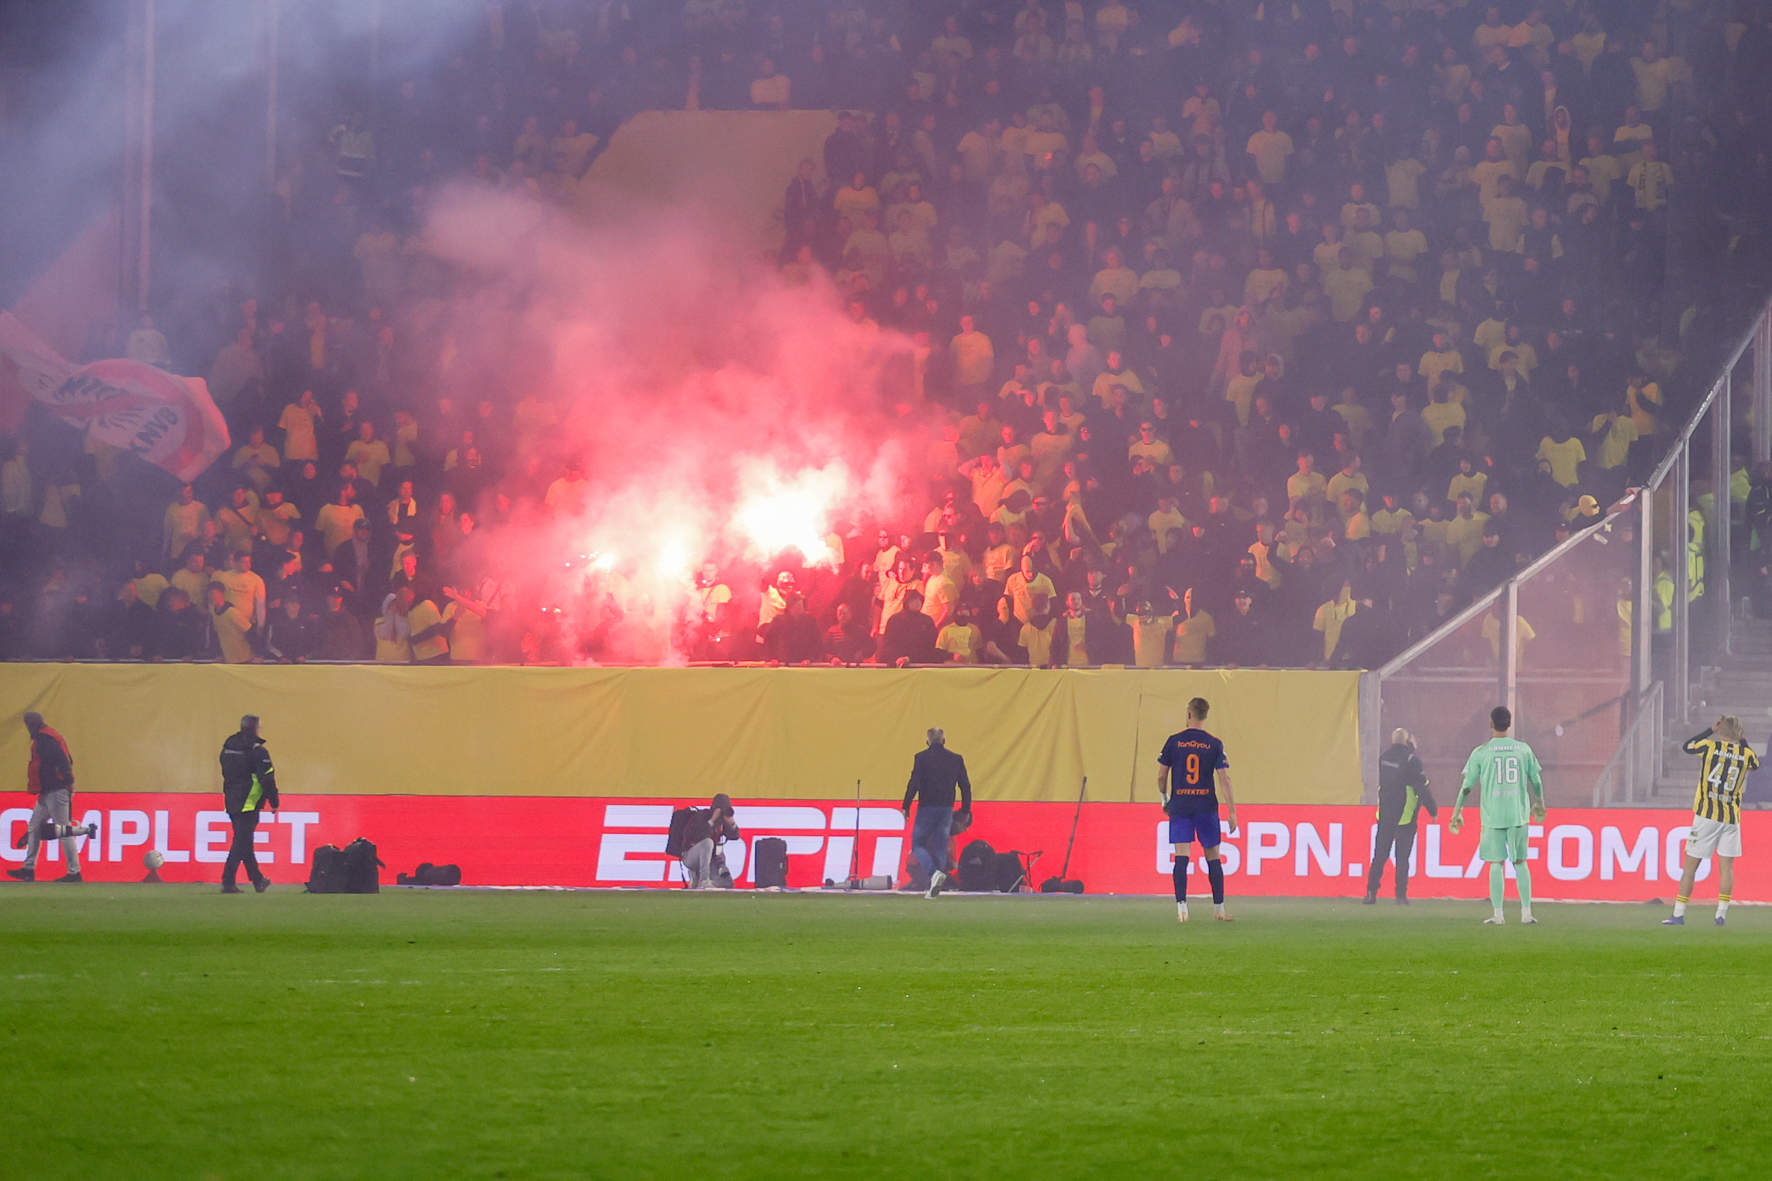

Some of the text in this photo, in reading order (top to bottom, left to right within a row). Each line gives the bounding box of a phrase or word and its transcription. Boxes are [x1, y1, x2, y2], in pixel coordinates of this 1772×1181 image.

[1186, 753, 1200, 785] 9
[1713, 749, 1745, 761] ARNHEM
[1494, 756, 1519, 784] 16
[1707, 762, 1740, 792] 43
